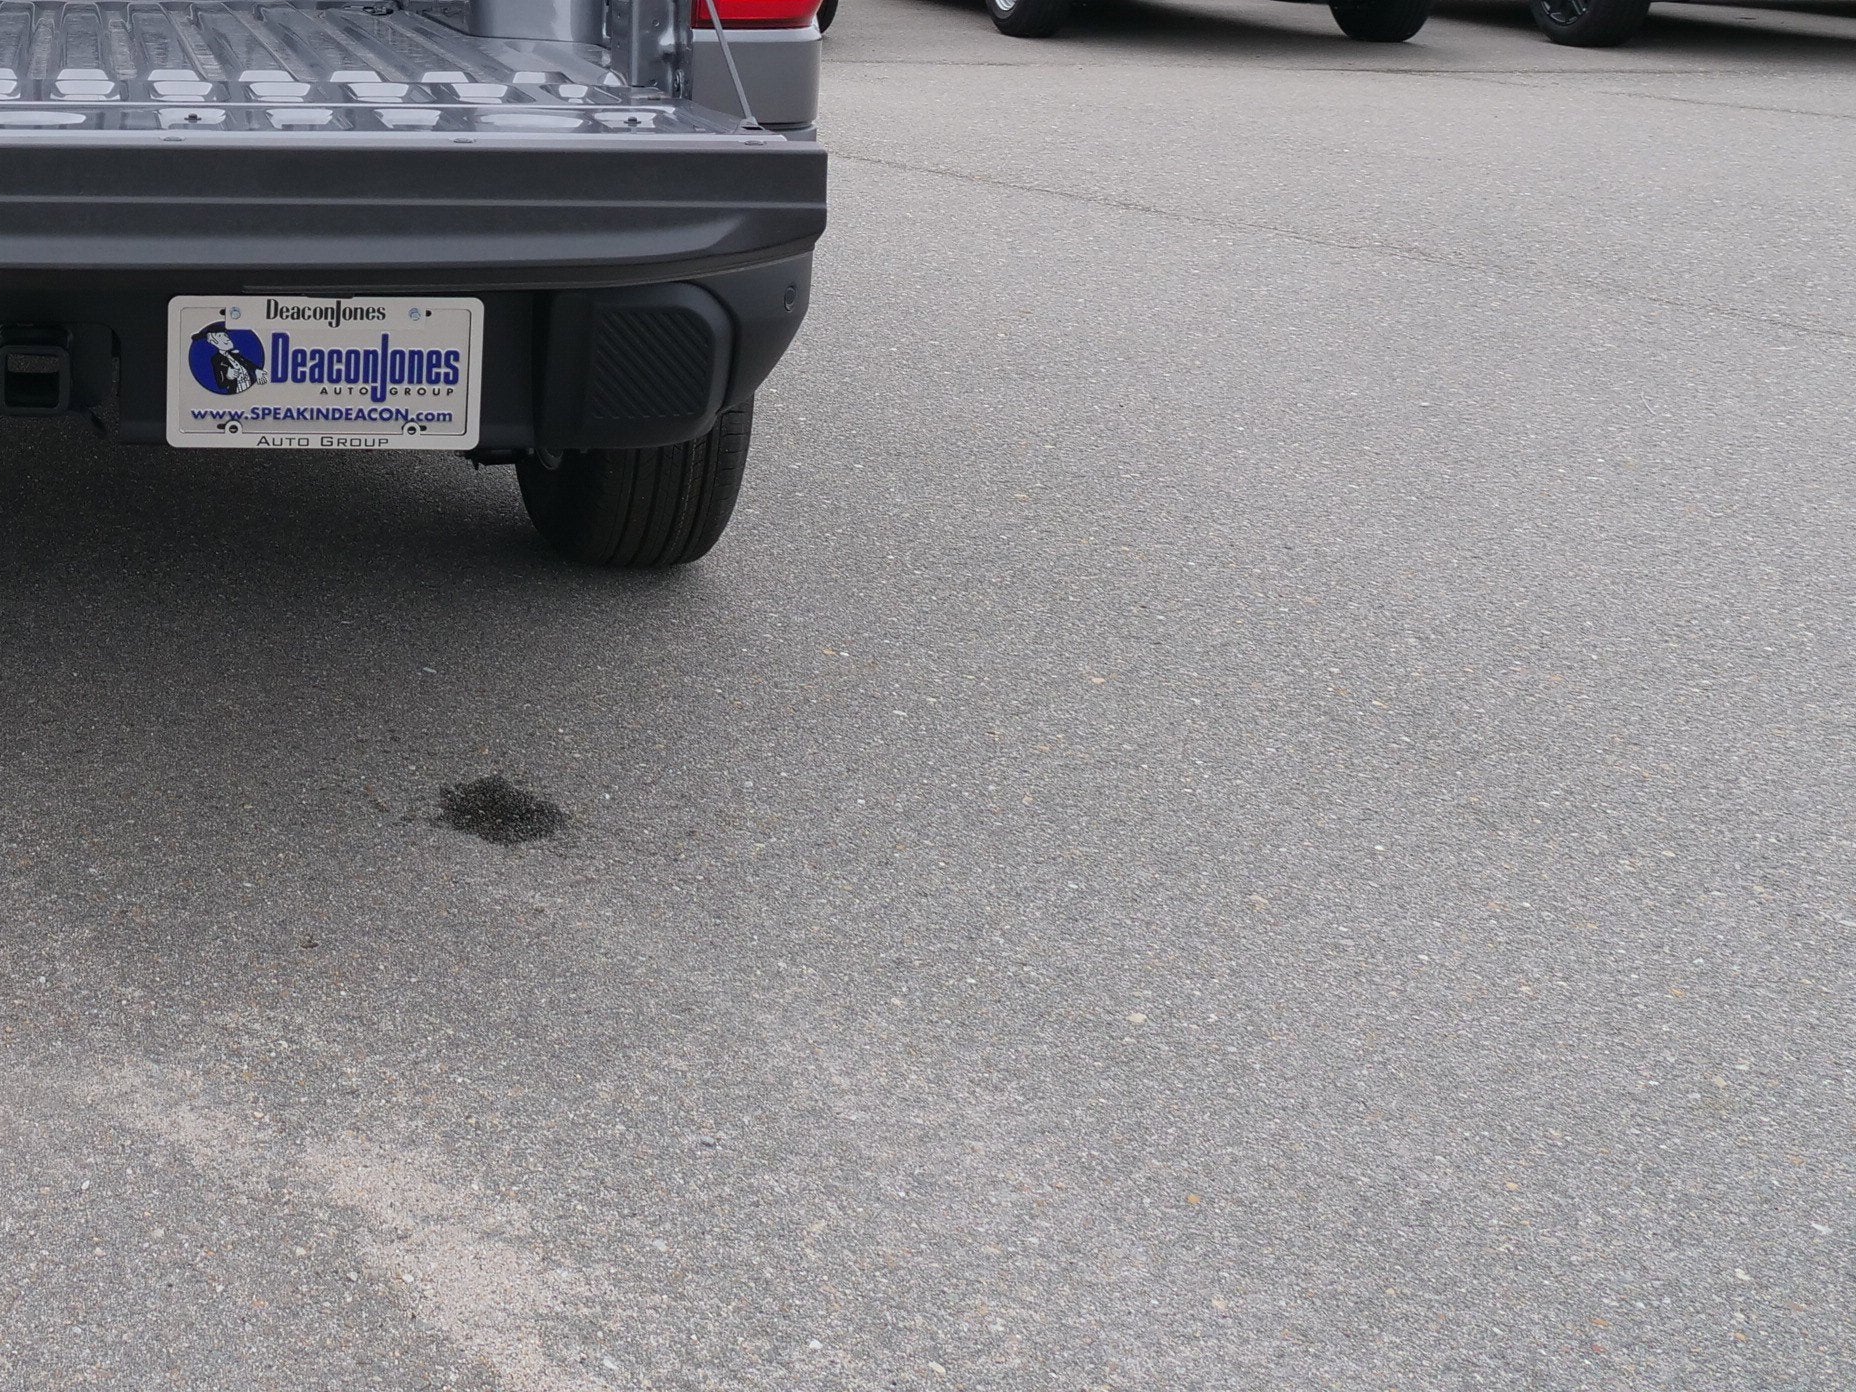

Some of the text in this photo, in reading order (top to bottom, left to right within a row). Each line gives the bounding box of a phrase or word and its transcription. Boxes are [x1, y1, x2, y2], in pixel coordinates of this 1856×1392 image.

[320, 386, 455, 397] AUTO GROUP
[191, 407, 453, 423] www.SPEAKINDEACON.com
